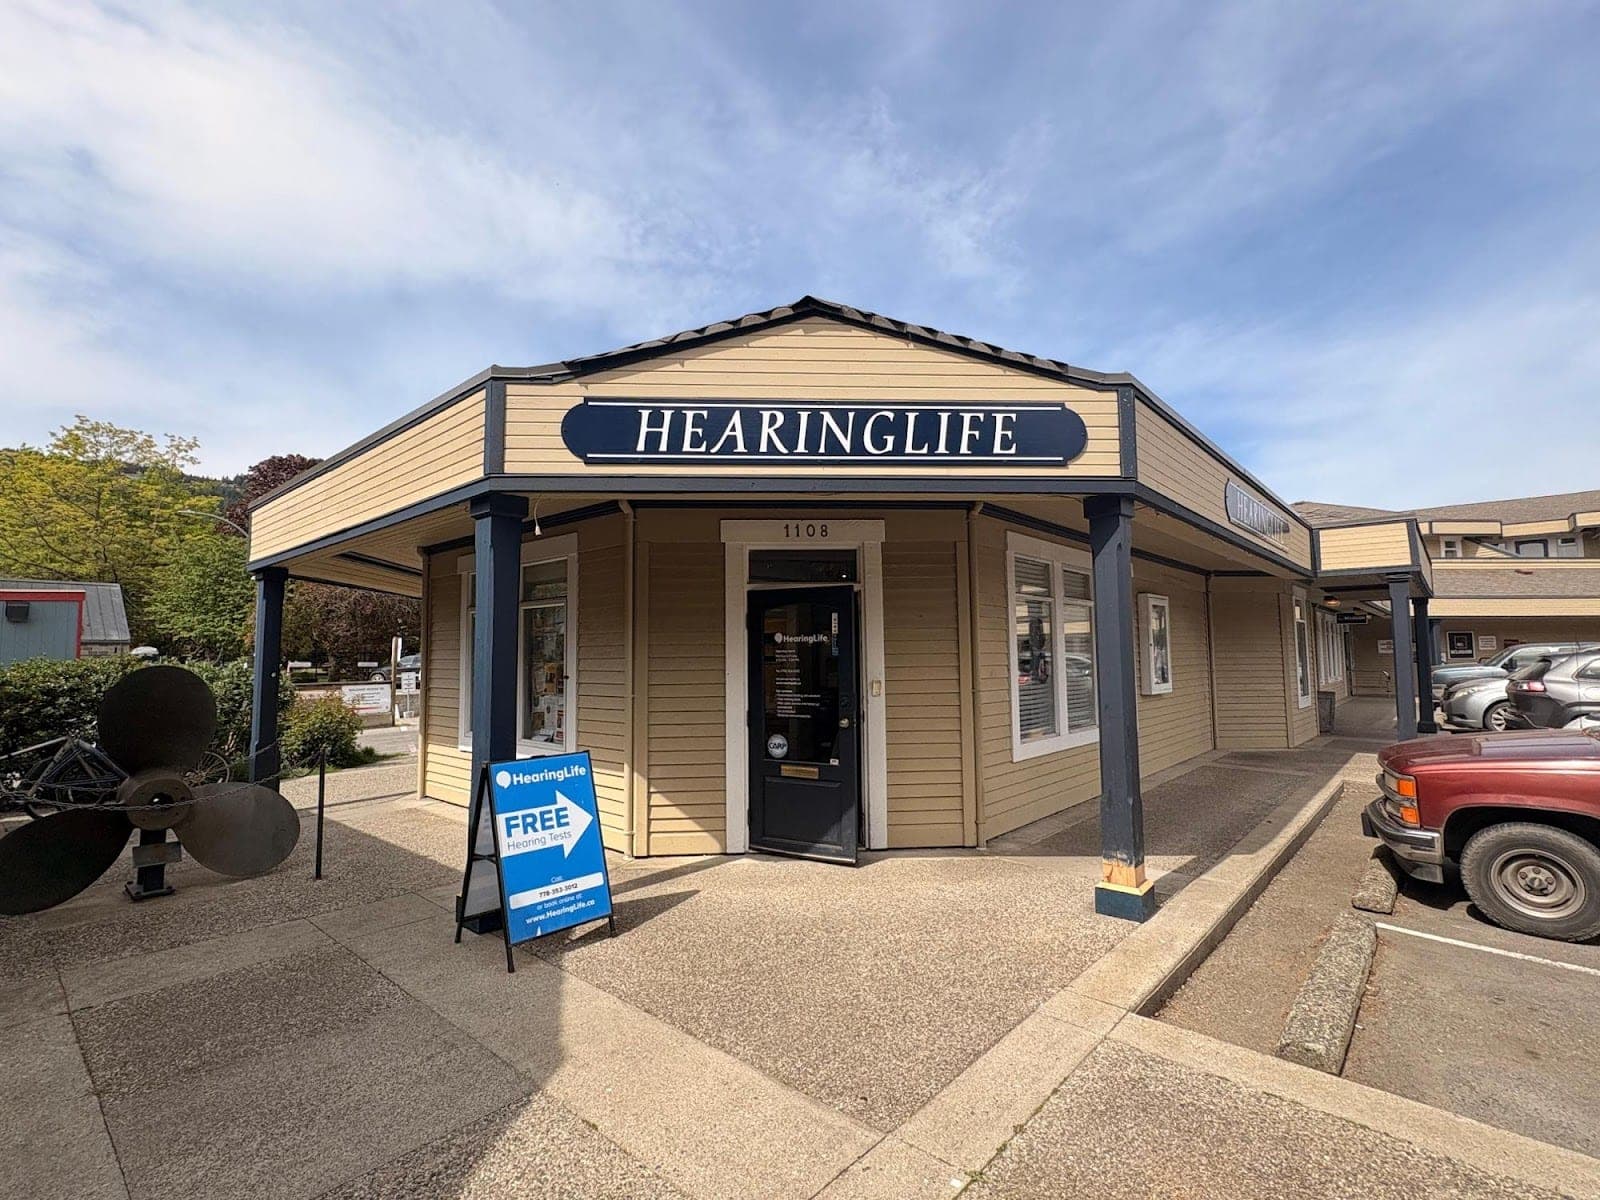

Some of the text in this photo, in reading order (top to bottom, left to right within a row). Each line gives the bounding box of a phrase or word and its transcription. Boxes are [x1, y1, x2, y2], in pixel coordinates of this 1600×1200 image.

[636, 409, 1018, 455] HEARINGLIFE
[784, 524, 828, 538] 1108
[783, 634, 828, 644] HearingLife
[513, 765, 586, 785] HearingLife
[504, 807, 570, 838] FREE
[507, 831, 572, 851] Hearing Tests
[526, 899, 595, 924] www.HearingLife.ca
